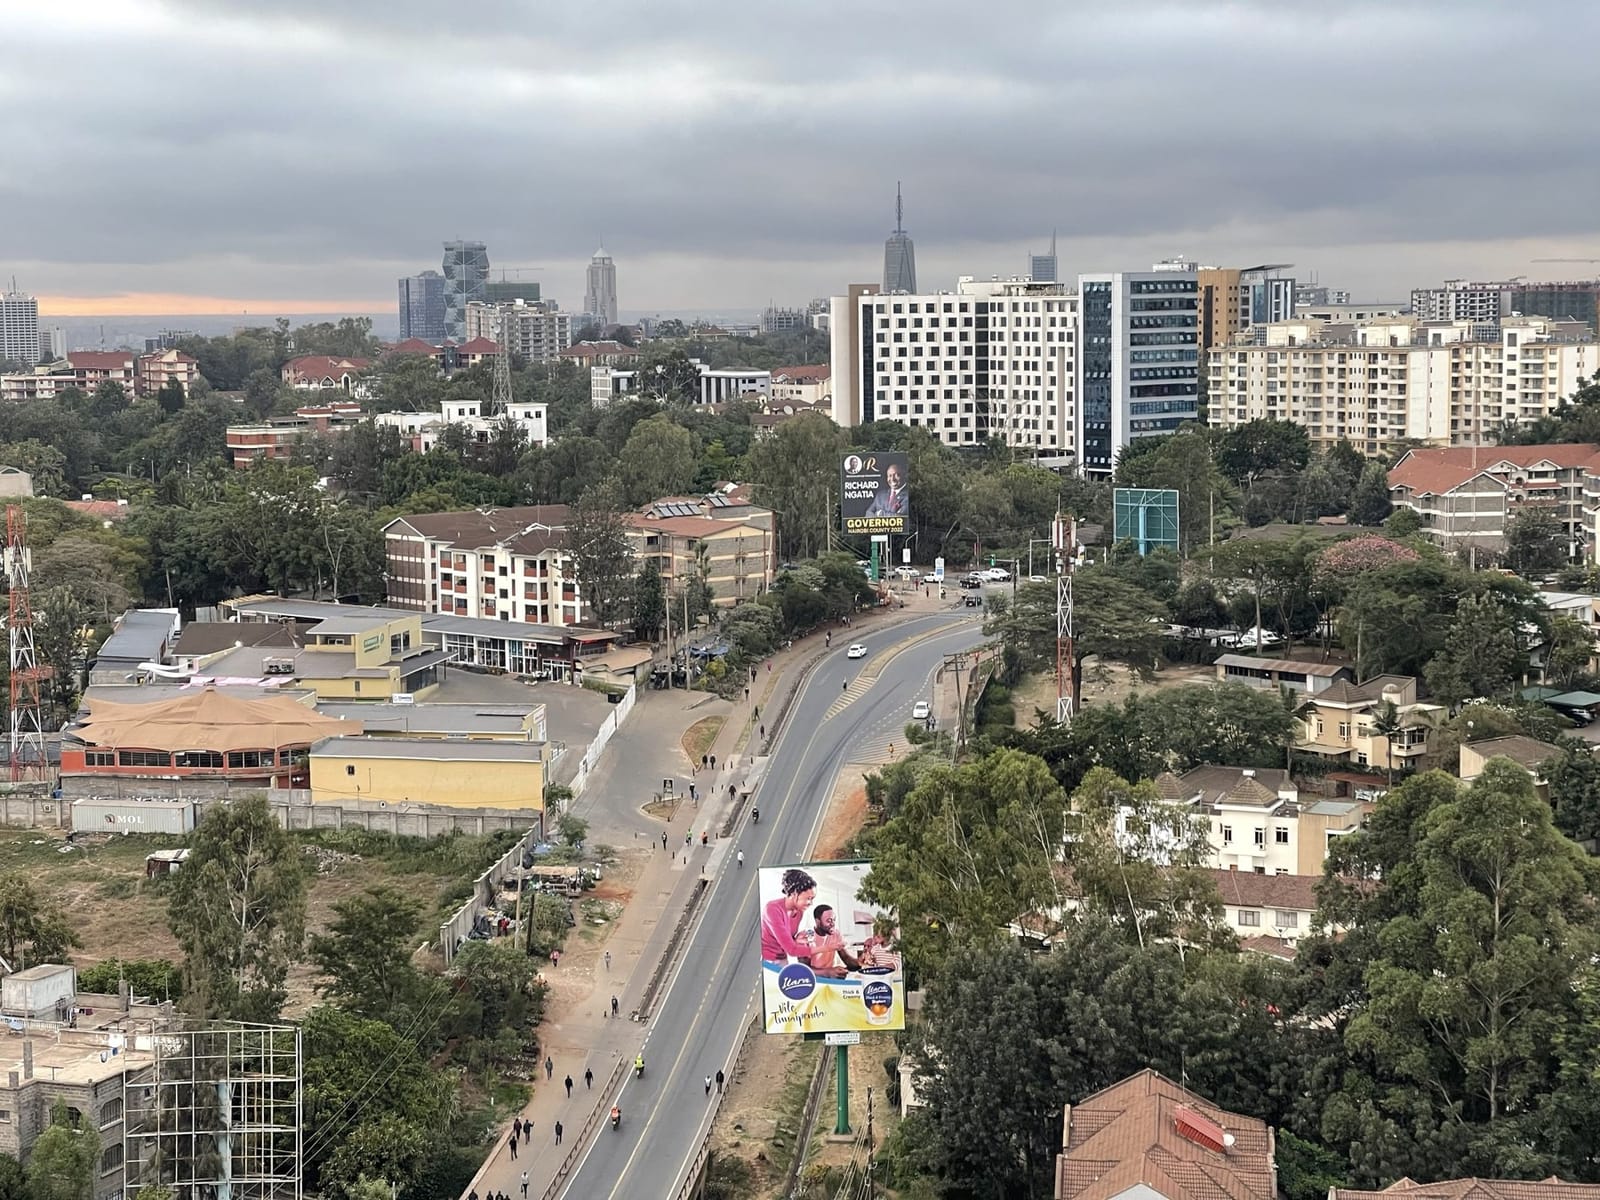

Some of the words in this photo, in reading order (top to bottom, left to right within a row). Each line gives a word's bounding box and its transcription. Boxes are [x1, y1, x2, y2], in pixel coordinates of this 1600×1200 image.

[844, 481, 879, 490] RICHARD
[844, 490, 874, 499] NGATIA
[847, 519, 903, 528] GOVERNOR
[117, 815, 144, 824] MOL
